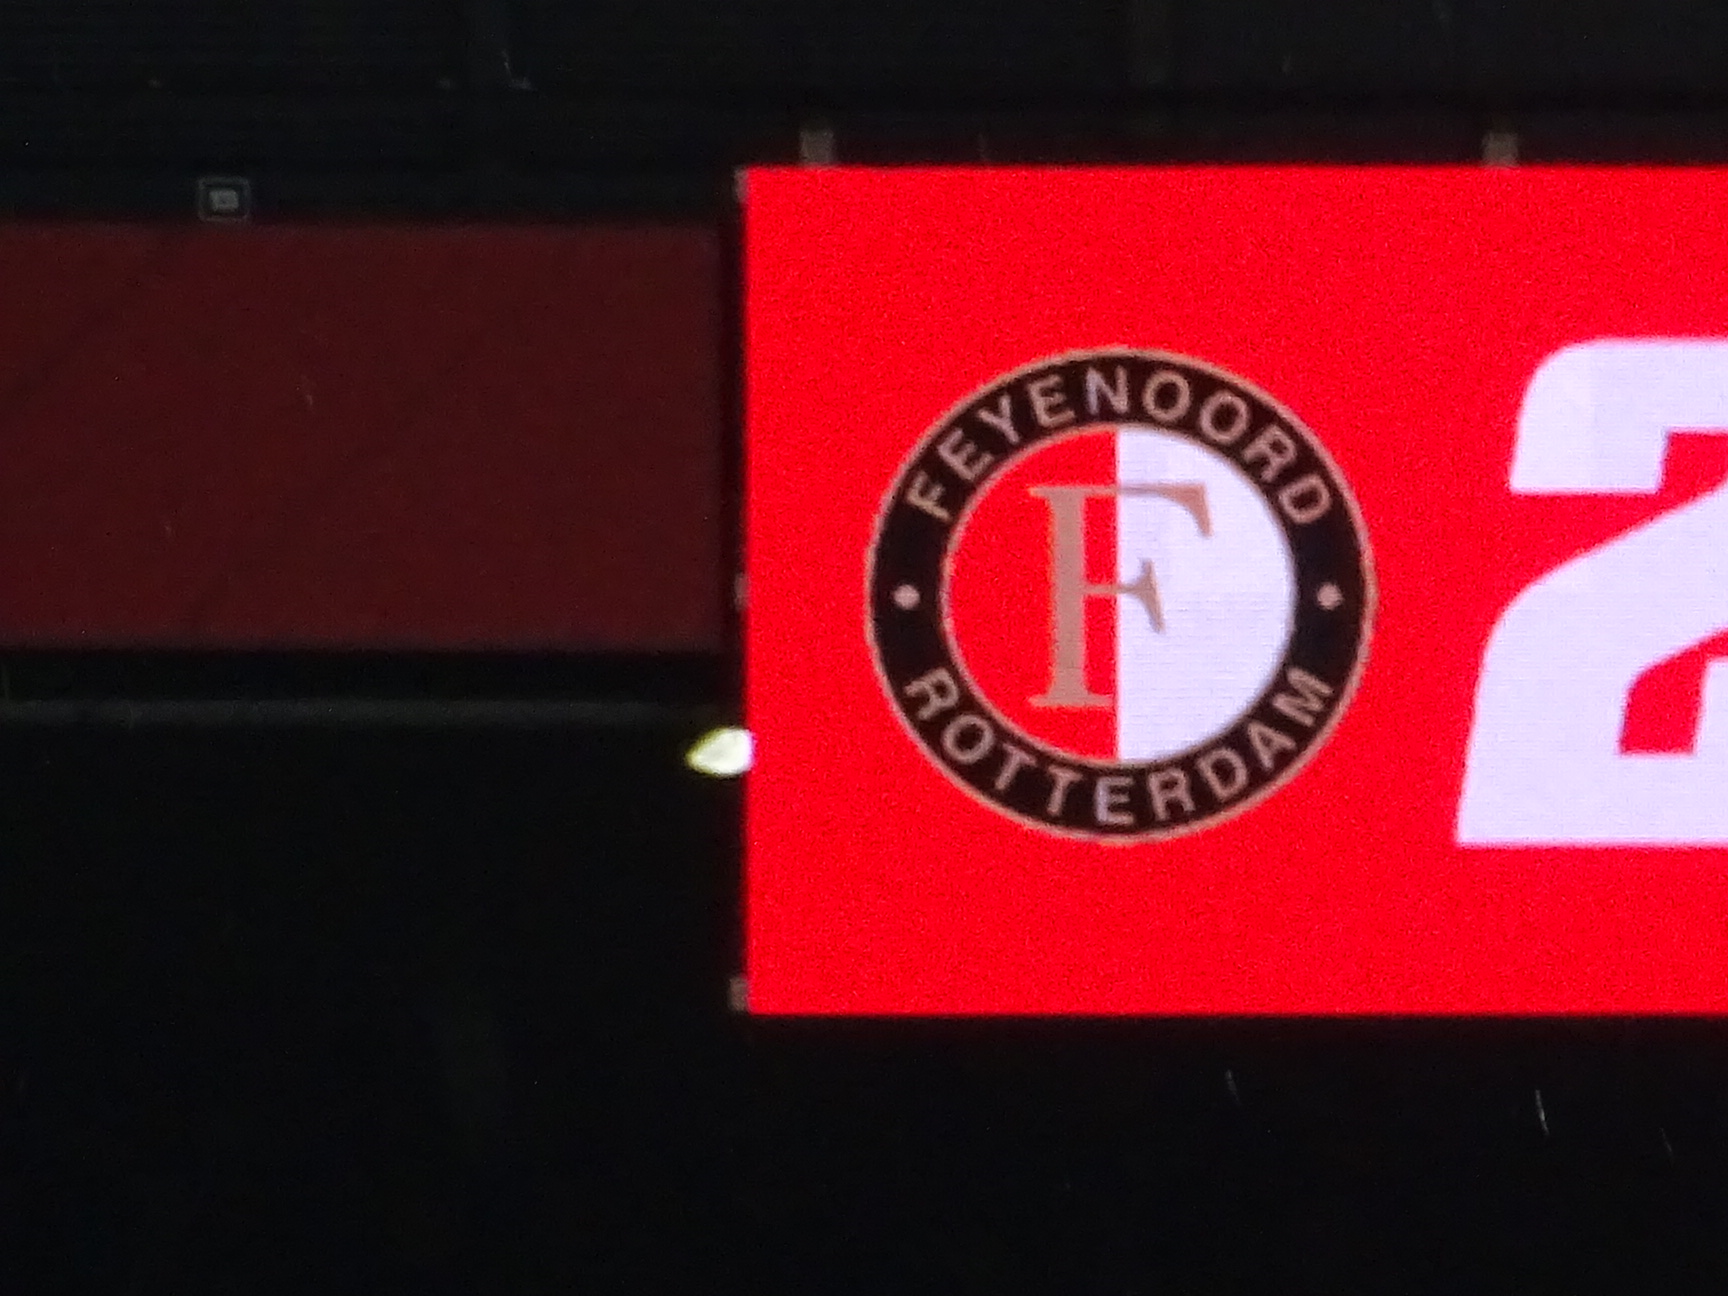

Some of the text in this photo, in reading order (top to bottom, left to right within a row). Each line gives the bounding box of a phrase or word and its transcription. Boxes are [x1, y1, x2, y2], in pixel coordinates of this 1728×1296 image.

[904, 364, 1332, 524] FEYENOORD
[1027, 481, 1214, 709] F
[904, 666, 1335, 828] ROTTERDAM
